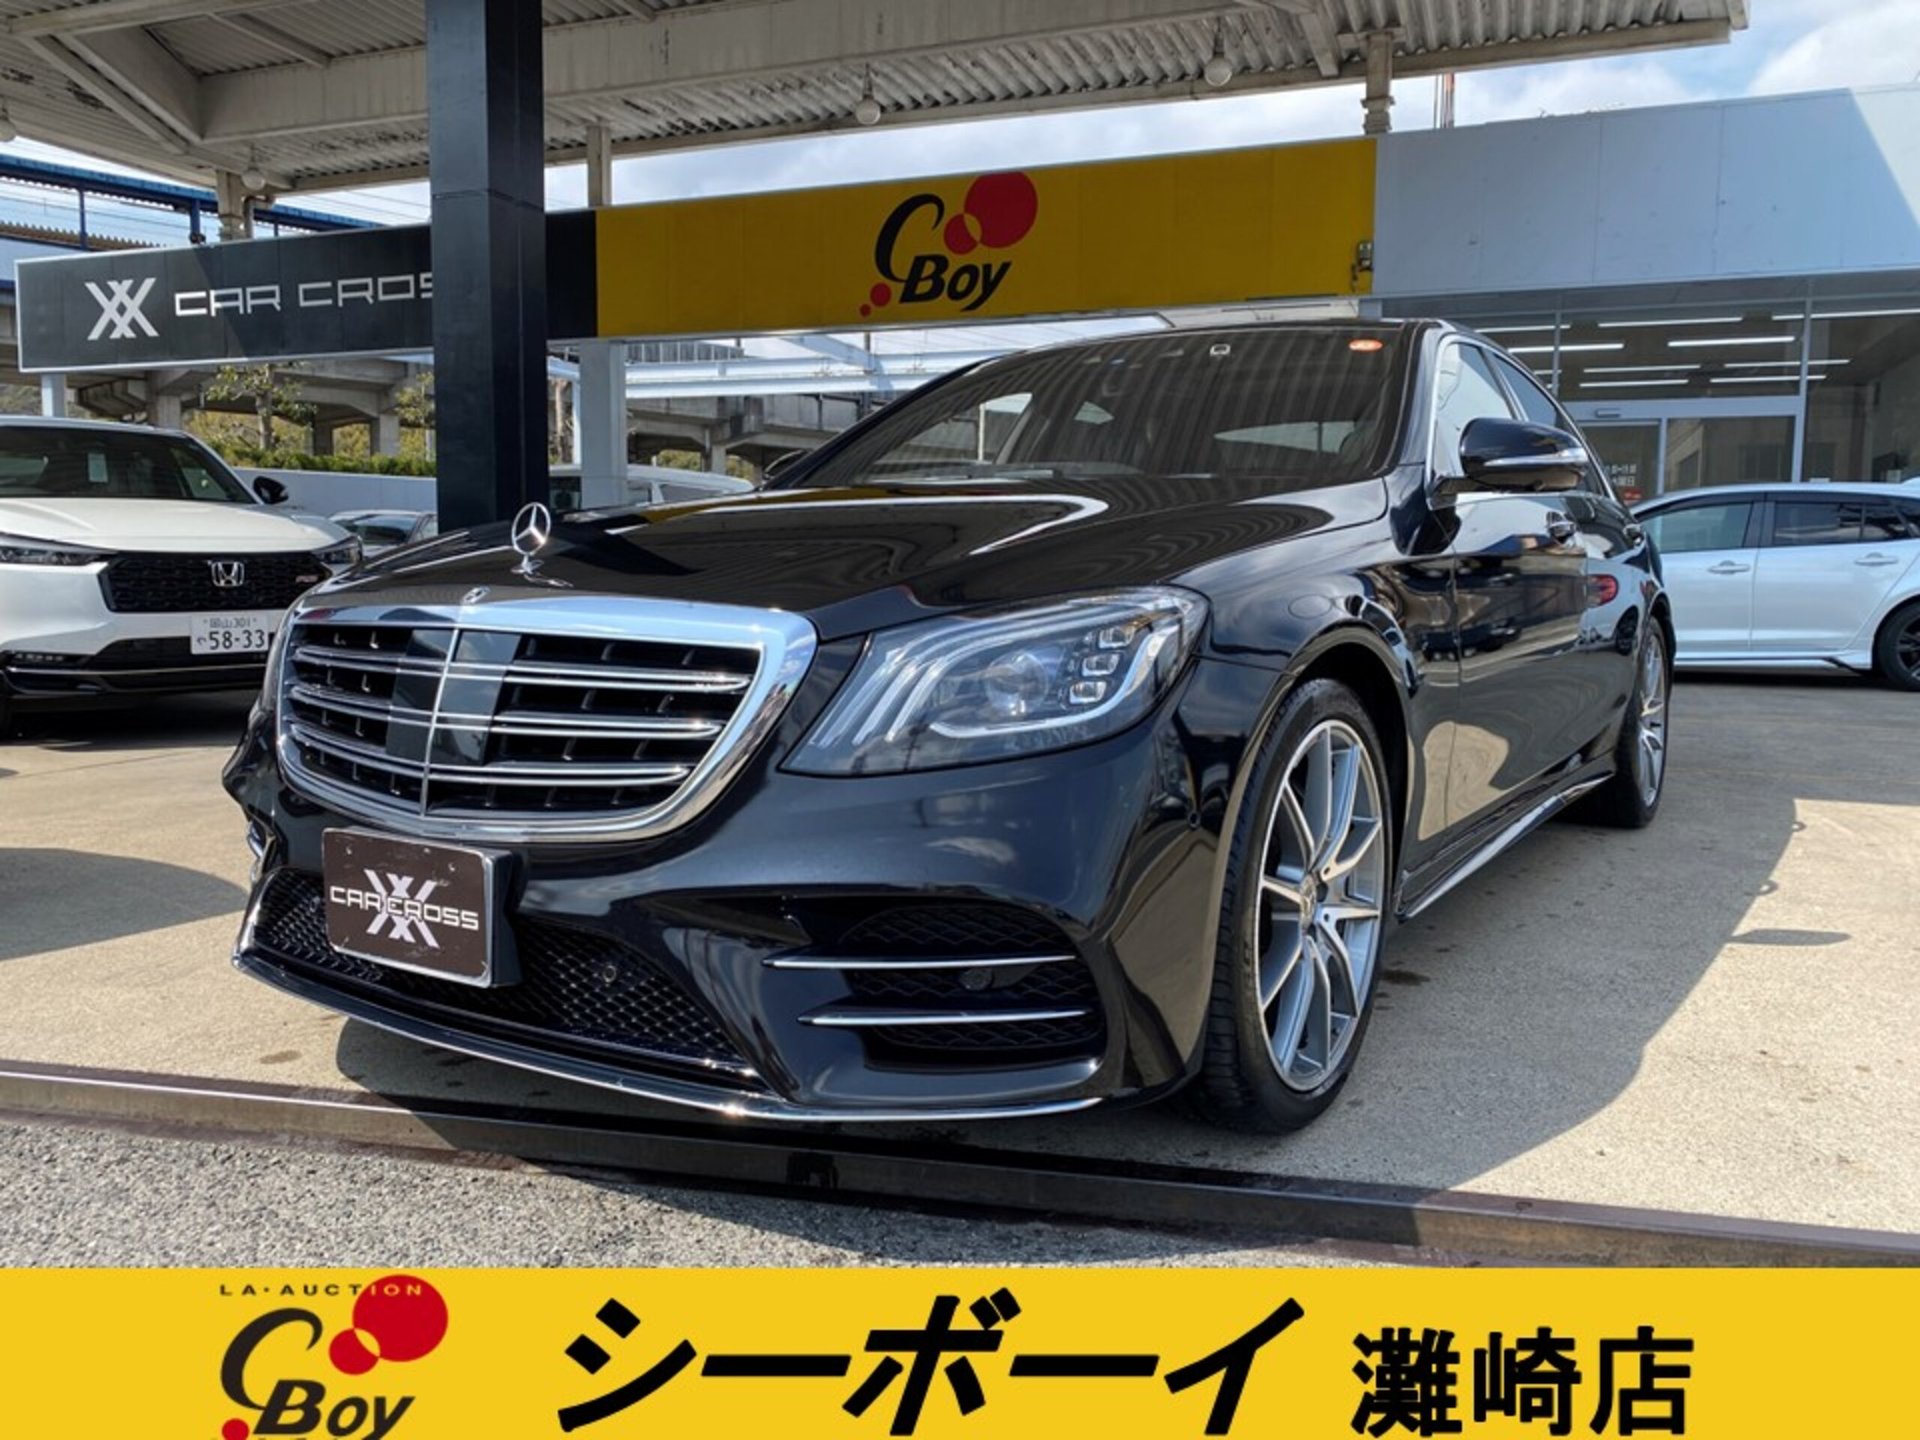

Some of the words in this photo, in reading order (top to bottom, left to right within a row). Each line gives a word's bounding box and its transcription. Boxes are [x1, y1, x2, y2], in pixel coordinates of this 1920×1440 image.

[175, 285, 281, 316] CAR
[900, 254, 1012, 312] Boy
[209, 629, 265, 650] 58-33
[330, 885, 381, 912] CAR
[387, 897, 479, 931] CROSS
